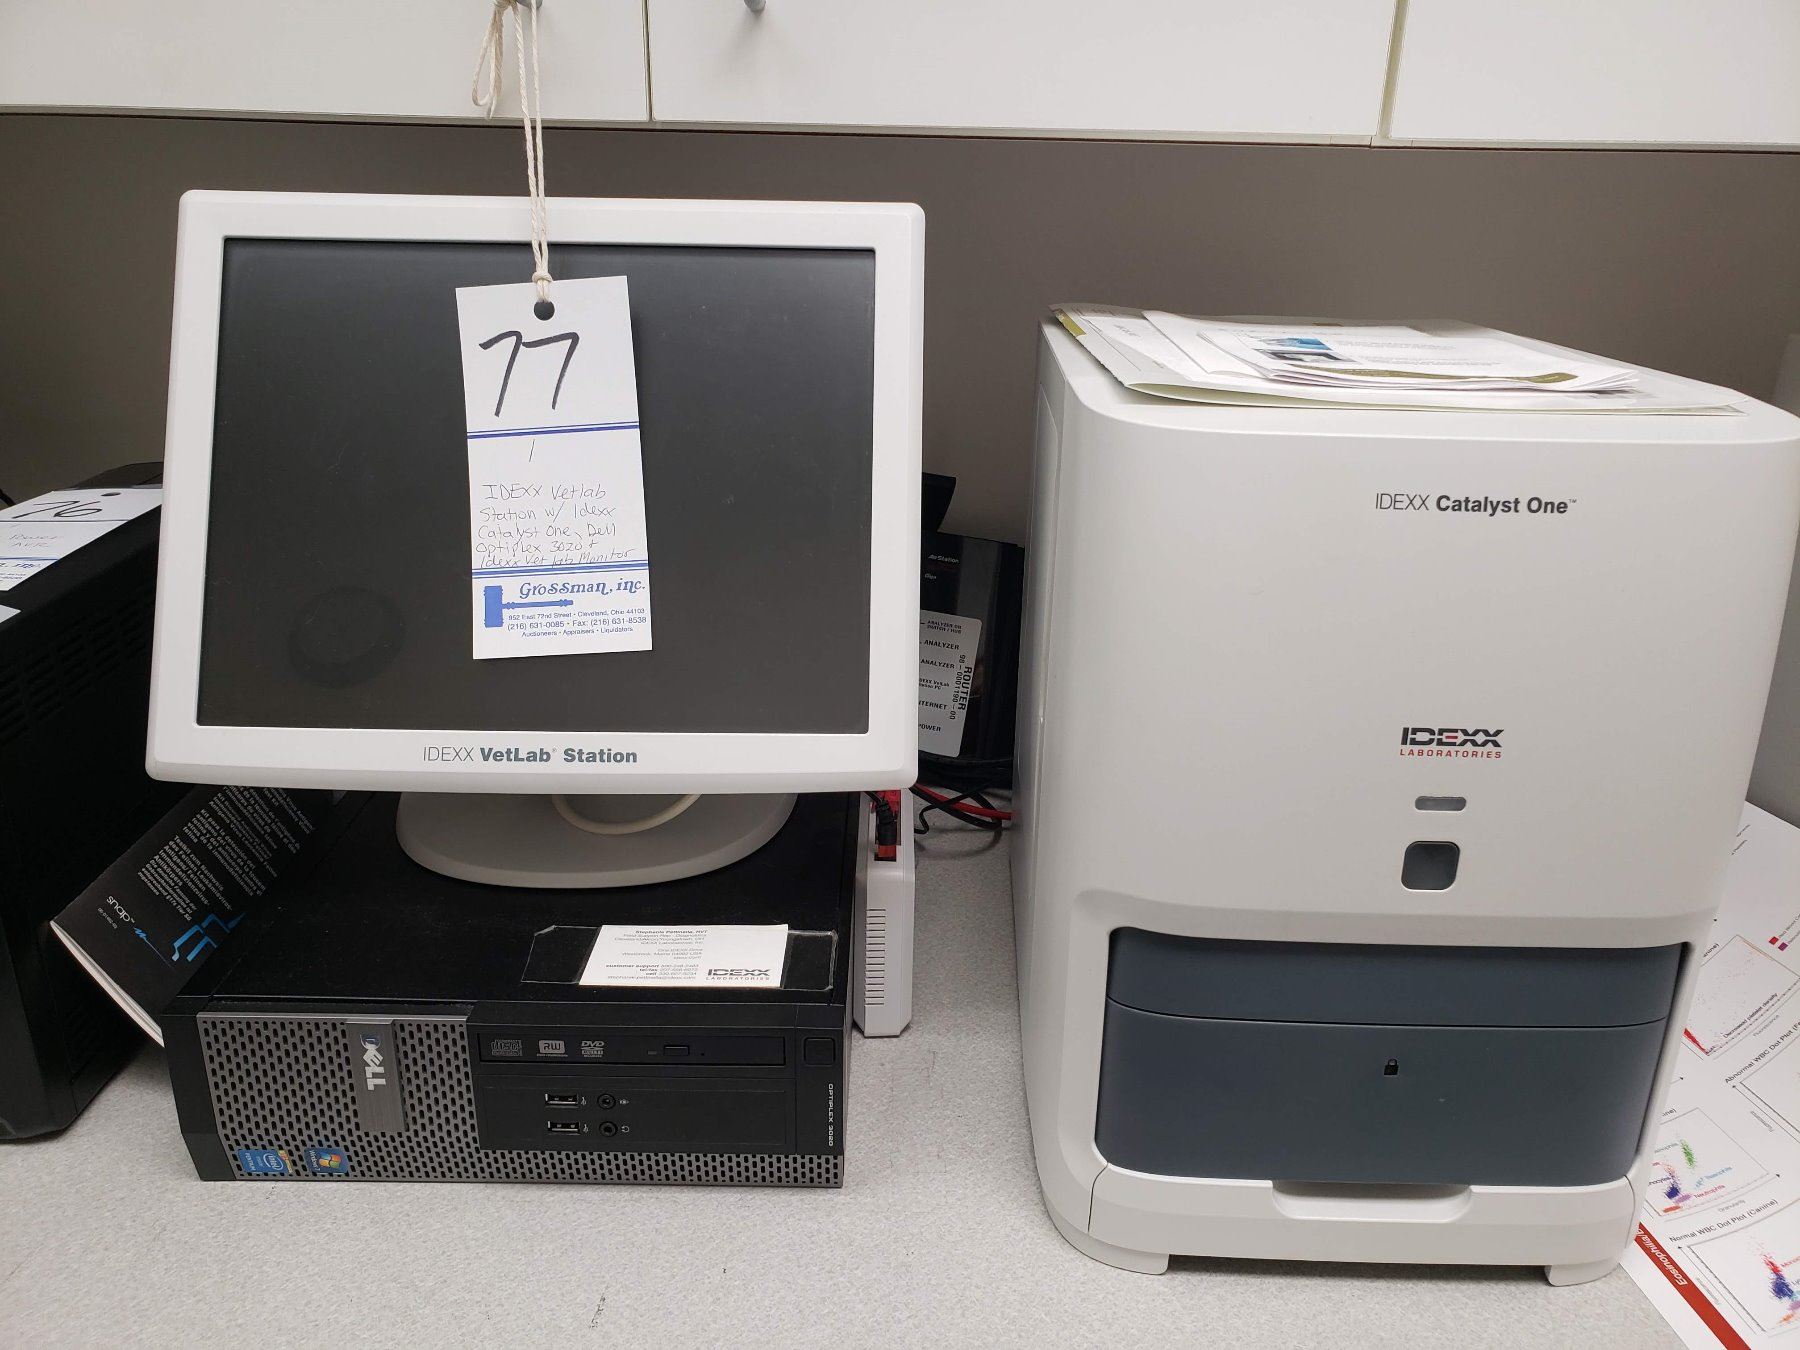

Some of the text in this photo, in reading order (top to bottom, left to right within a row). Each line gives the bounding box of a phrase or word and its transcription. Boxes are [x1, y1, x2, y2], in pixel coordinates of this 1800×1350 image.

[478, 330, 580, 417] 77
[482, 482, 543, 500] IDEXX
[12, 500, 103, 519] 76
[479, 505, 537, 522] Station
[1375, 493, 1430, 511] IDEXX
[1435, 495, 1521, 517] Catalyst
[478, 523, 540, 544] Catalyst
[616, 578, 646, 594] inc.
[924, 639, 960, 650] ANALYZER
[920, 658, 956, 669] ANALYZER
[957, 666, 973, 711] ROUTER
[919, 723, 941, 732] OWER
[1400, 727, 1504, 748] IDEXX
[423, 746, 475, 762] IDEXX
[563, 748, 638, 763] Station
[1399, 748, 1502, 759] LABORATORIES
[707, 968, 771, 976] IDEXX
[581, 1040, 605, 1048] DVD
[359, 1033, 387, 1091] DELL
[1724, 1059, 1755, 1084] Abnormal
[1752, 1047, 1769, 1062] WBC
[1669, 1225, 1697, 1243] Normal
[1696, 1222, 1718, 1239] WBC
[1746, 1199, 1780, 1221] (Canine)
